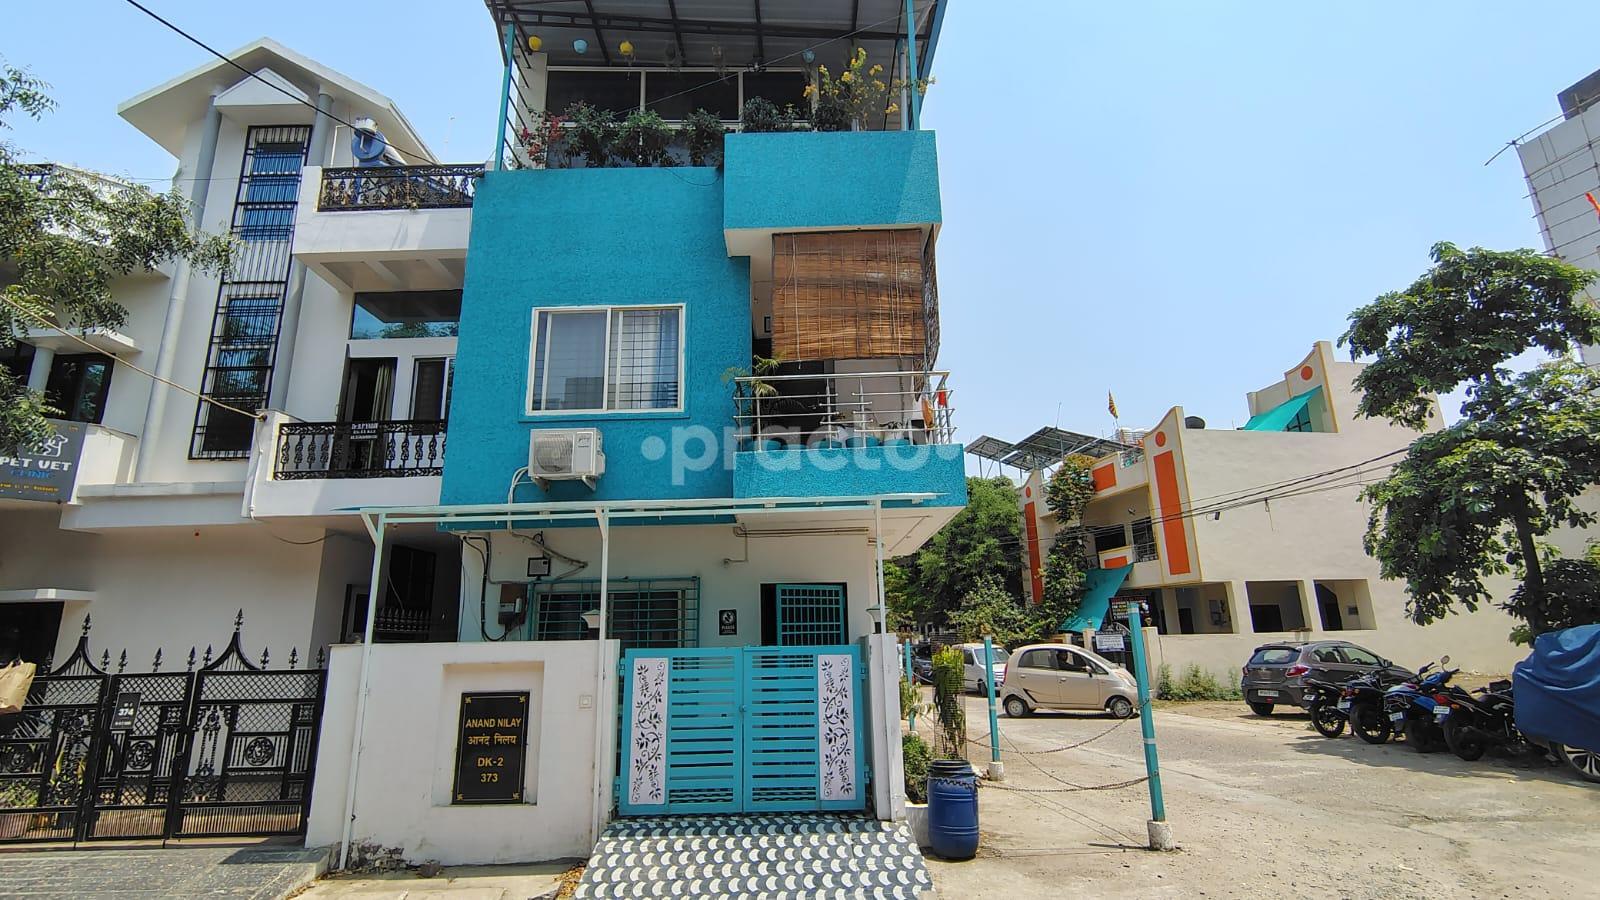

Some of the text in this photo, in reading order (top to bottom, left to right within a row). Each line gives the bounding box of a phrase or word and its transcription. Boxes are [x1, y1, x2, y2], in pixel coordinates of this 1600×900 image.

[0, 456, 72, 471] PET VET
[465, 718, 522, 728] ANAND NILAY
[468, 732, 517, 746] आनंद निलय
[477, 757, 504, 767] DK-2
[480, 773, 498, 783] 373
